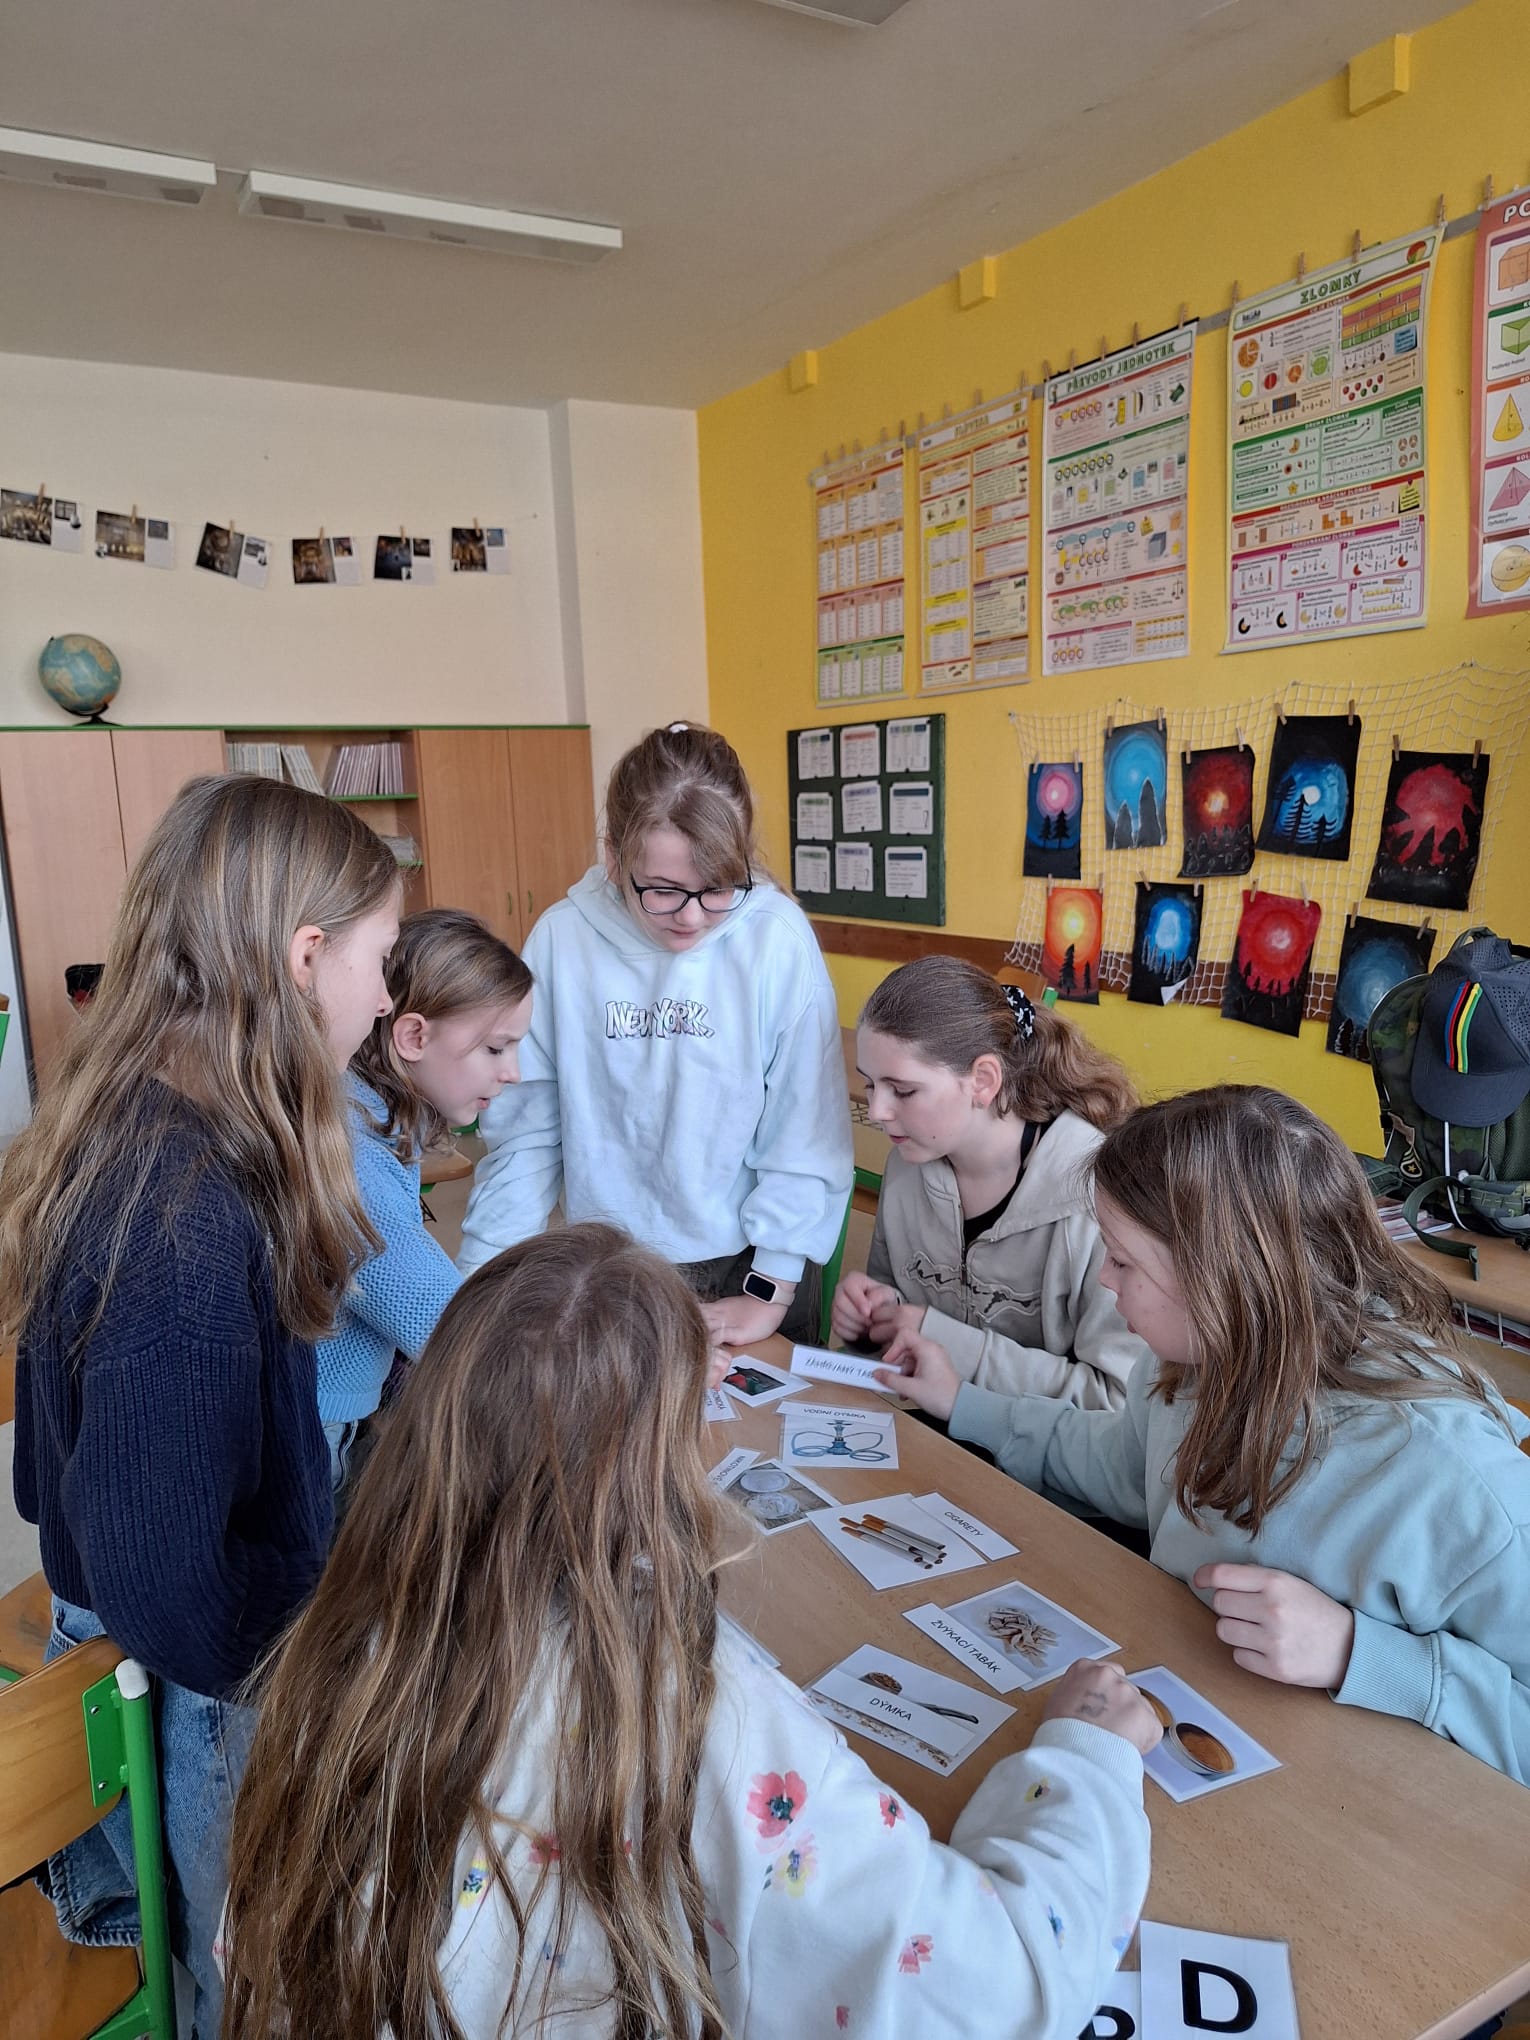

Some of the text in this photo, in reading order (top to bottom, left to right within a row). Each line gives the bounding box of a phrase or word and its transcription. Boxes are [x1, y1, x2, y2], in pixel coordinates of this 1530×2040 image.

[1300, 269, 1361, 304] ZLOMKY
[1117, 341, 1176, 374] JEDNOTEK
[651, 998, 715, 1039] YORK
[944, 1510, 983, 1537] CIGARETY
[931, 1619, 1001, 1674] ŽVÝKACÍ TABÁK
[869, 1697, 913, 1721] DÝMKA
[1180, 1958, 1258, 2034] D
